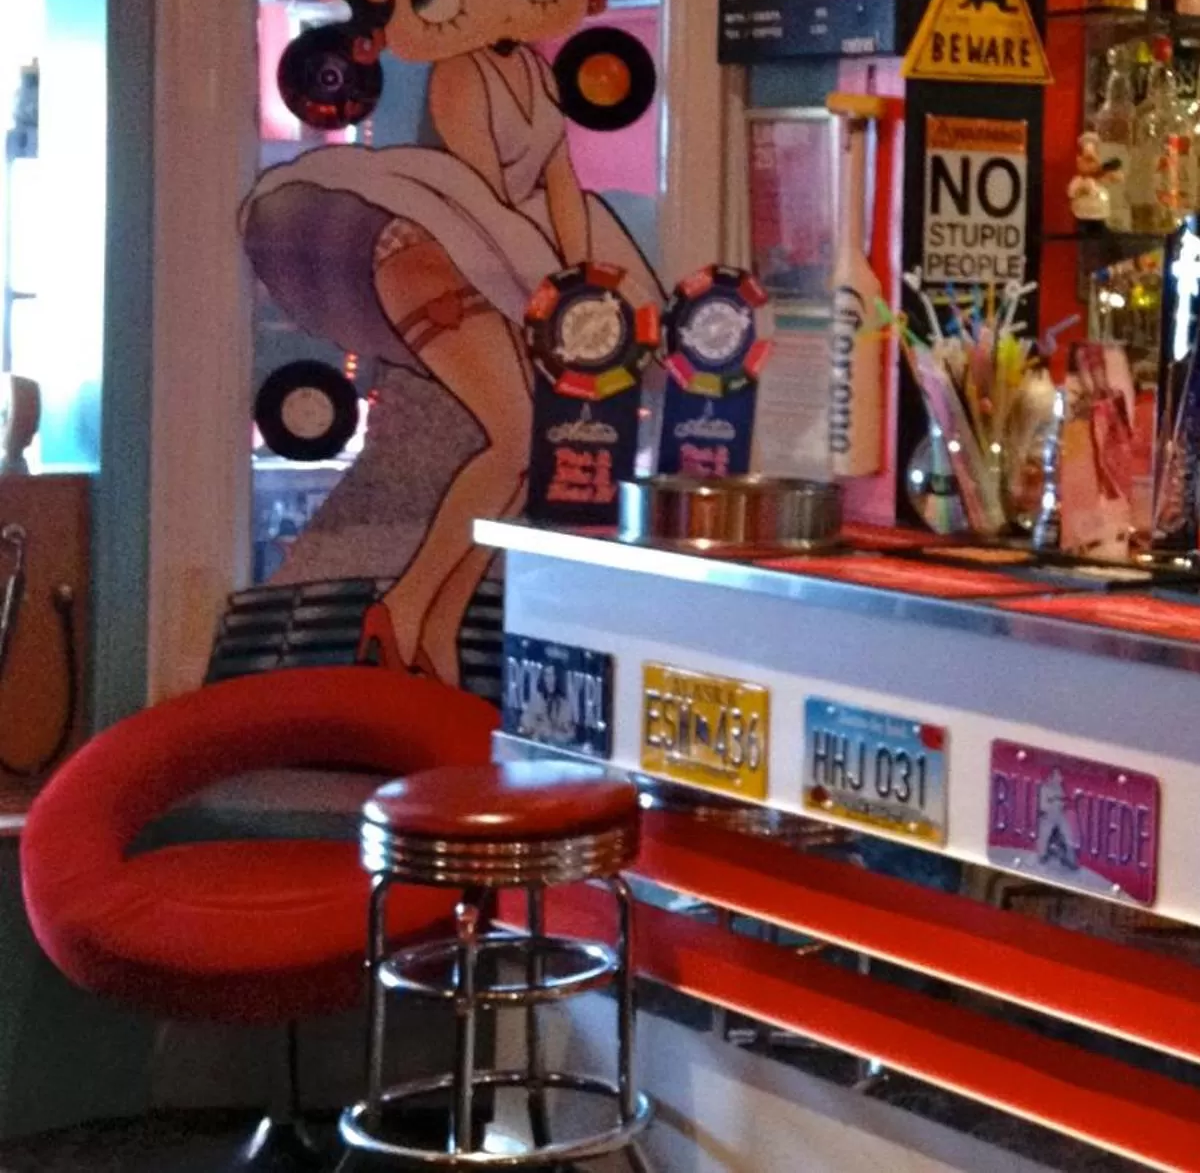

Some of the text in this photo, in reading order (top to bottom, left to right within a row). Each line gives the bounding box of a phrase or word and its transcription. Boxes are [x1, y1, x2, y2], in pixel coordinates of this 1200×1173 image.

[931, 31, 1032, 68] BEWARE
[929, 154, 1021, 218] NO
[929, 222, 1021, 249] STUPID
[927, 253, 1021, 278] PEOPLE
[812, 728, 867, 791] HHJ
[876, 743, 927, 810] 031
